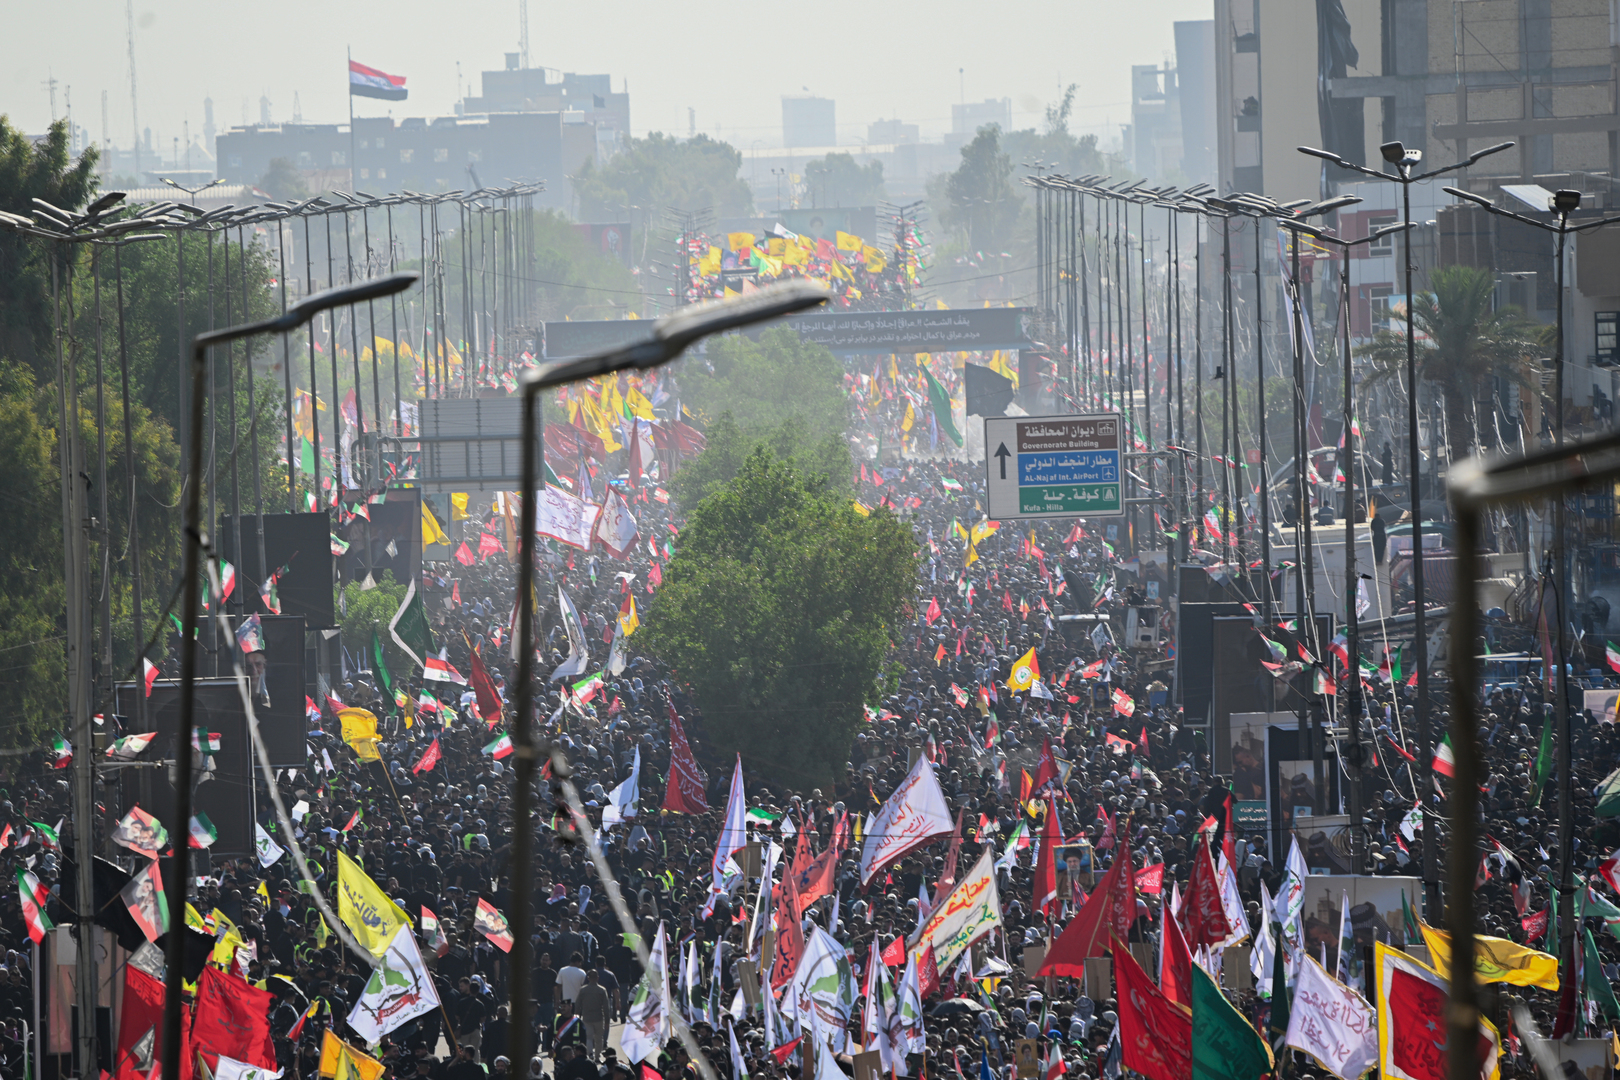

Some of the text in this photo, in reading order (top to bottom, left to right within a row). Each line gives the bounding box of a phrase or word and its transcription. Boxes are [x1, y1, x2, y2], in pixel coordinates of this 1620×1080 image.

[1024, 425, 1094, 438] ديوان المحافظة
[1025, 455, 1112, 472] مطار النجف الدولي
[1042, 489, 1065, 500] حلة
[1072, 488, 1100, 502] كوفة
